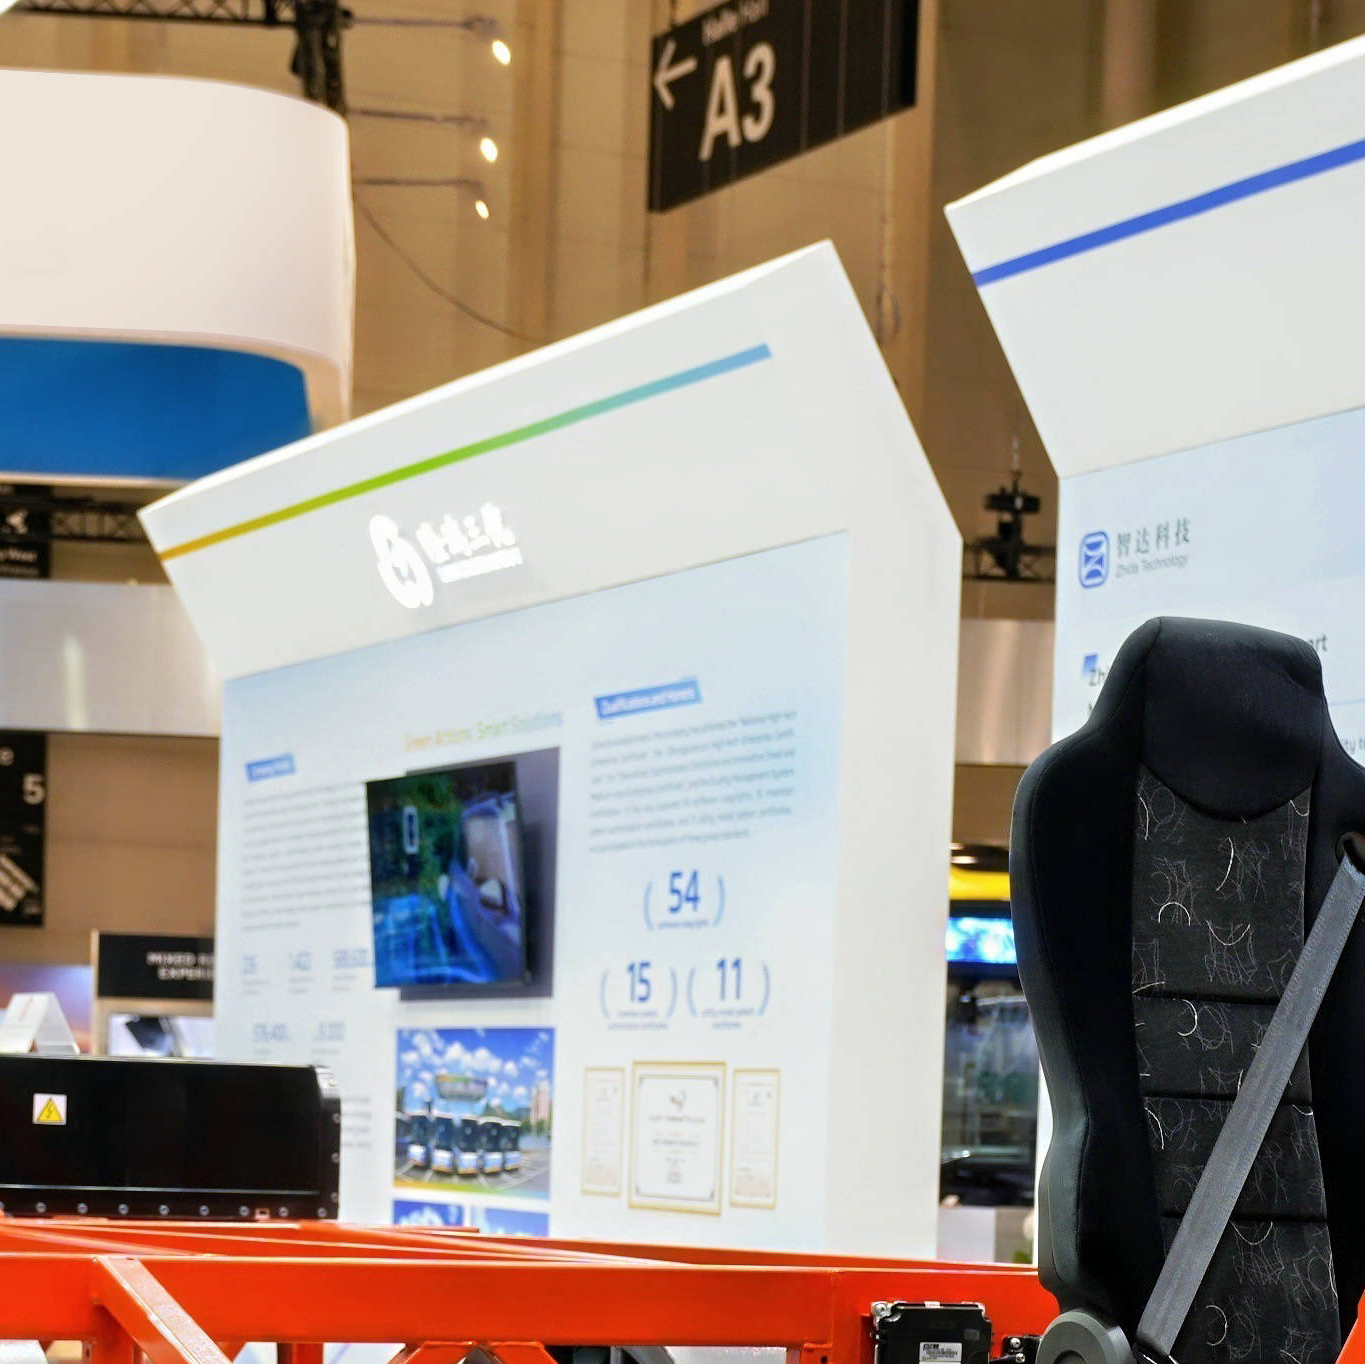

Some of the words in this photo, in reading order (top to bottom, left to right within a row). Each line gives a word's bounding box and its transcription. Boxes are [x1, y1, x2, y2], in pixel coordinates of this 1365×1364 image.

[699, 42, 776, 162] A3
[1117, 517, 1191, 557] 智达科技
[1142, 553, 1189, 571] Technology
[22, 773, 46, 805] 5
[668, 869, 700, 913] 54
[628, 961, 652, 1003] 15
[717, 957, 742, 1000] 11
